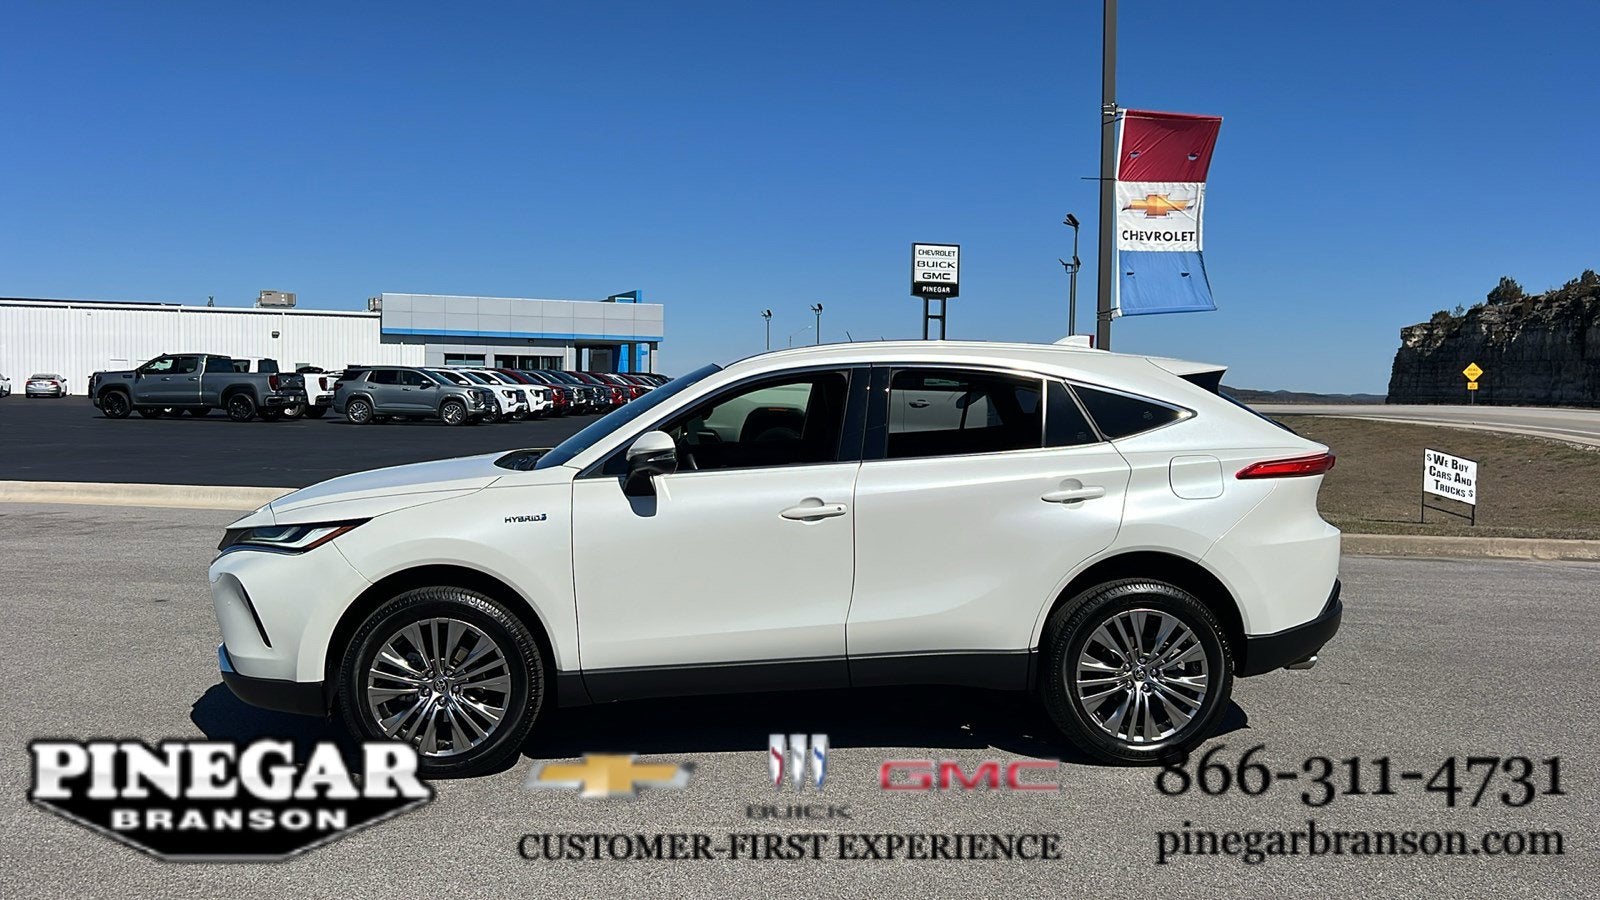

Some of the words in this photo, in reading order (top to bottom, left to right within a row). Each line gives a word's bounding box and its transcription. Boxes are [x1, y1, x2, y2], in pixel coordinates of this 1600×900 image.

[1122, 230, 1195, 242] CHEVROLET
[918, 249, 956, 257] CHEVROLET
[917, 260, 956, 269] BUICK
[922, 272, 951, 280] GMC
[922, 285, 951, 293] PINEGAR
[504, 515, 540, 523] HYBRID
